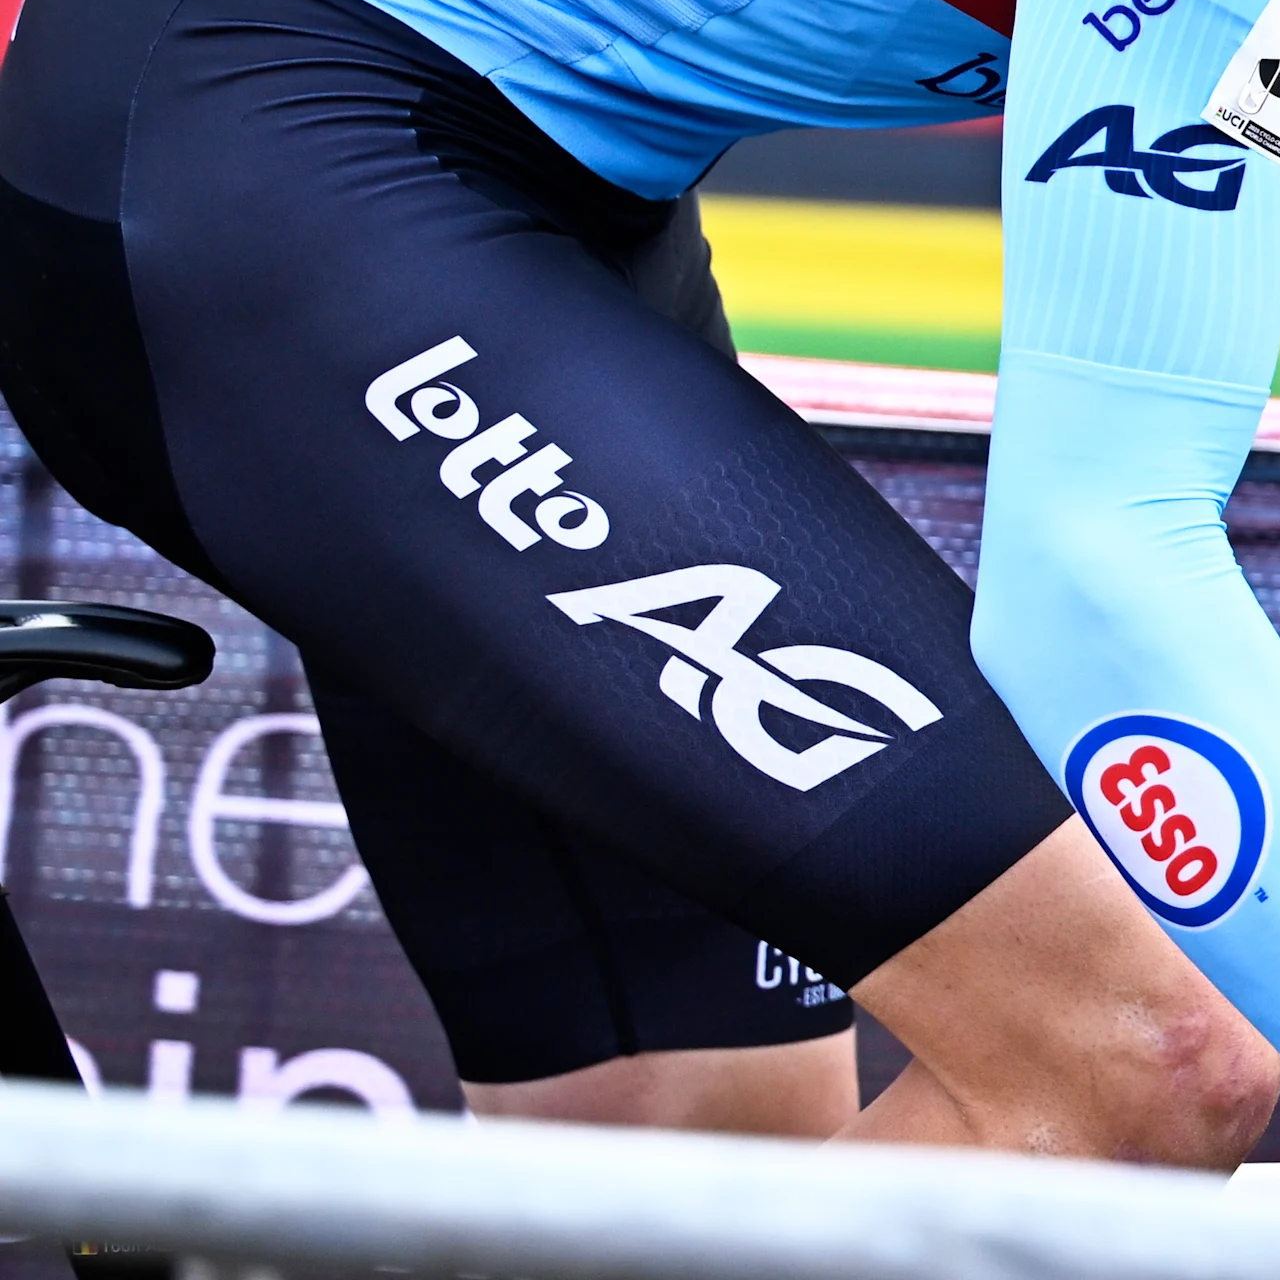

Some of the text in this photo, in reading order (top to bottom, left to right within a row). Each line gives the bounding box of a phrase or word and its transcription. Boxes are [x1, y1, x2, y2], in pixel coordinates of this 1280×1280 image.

[1024, 104, 1250, 212] AG
[1222, 108, 1246, 130] UCI
[364, 334, 611, 553] lotto
[544, 563, 945, 792] AG
